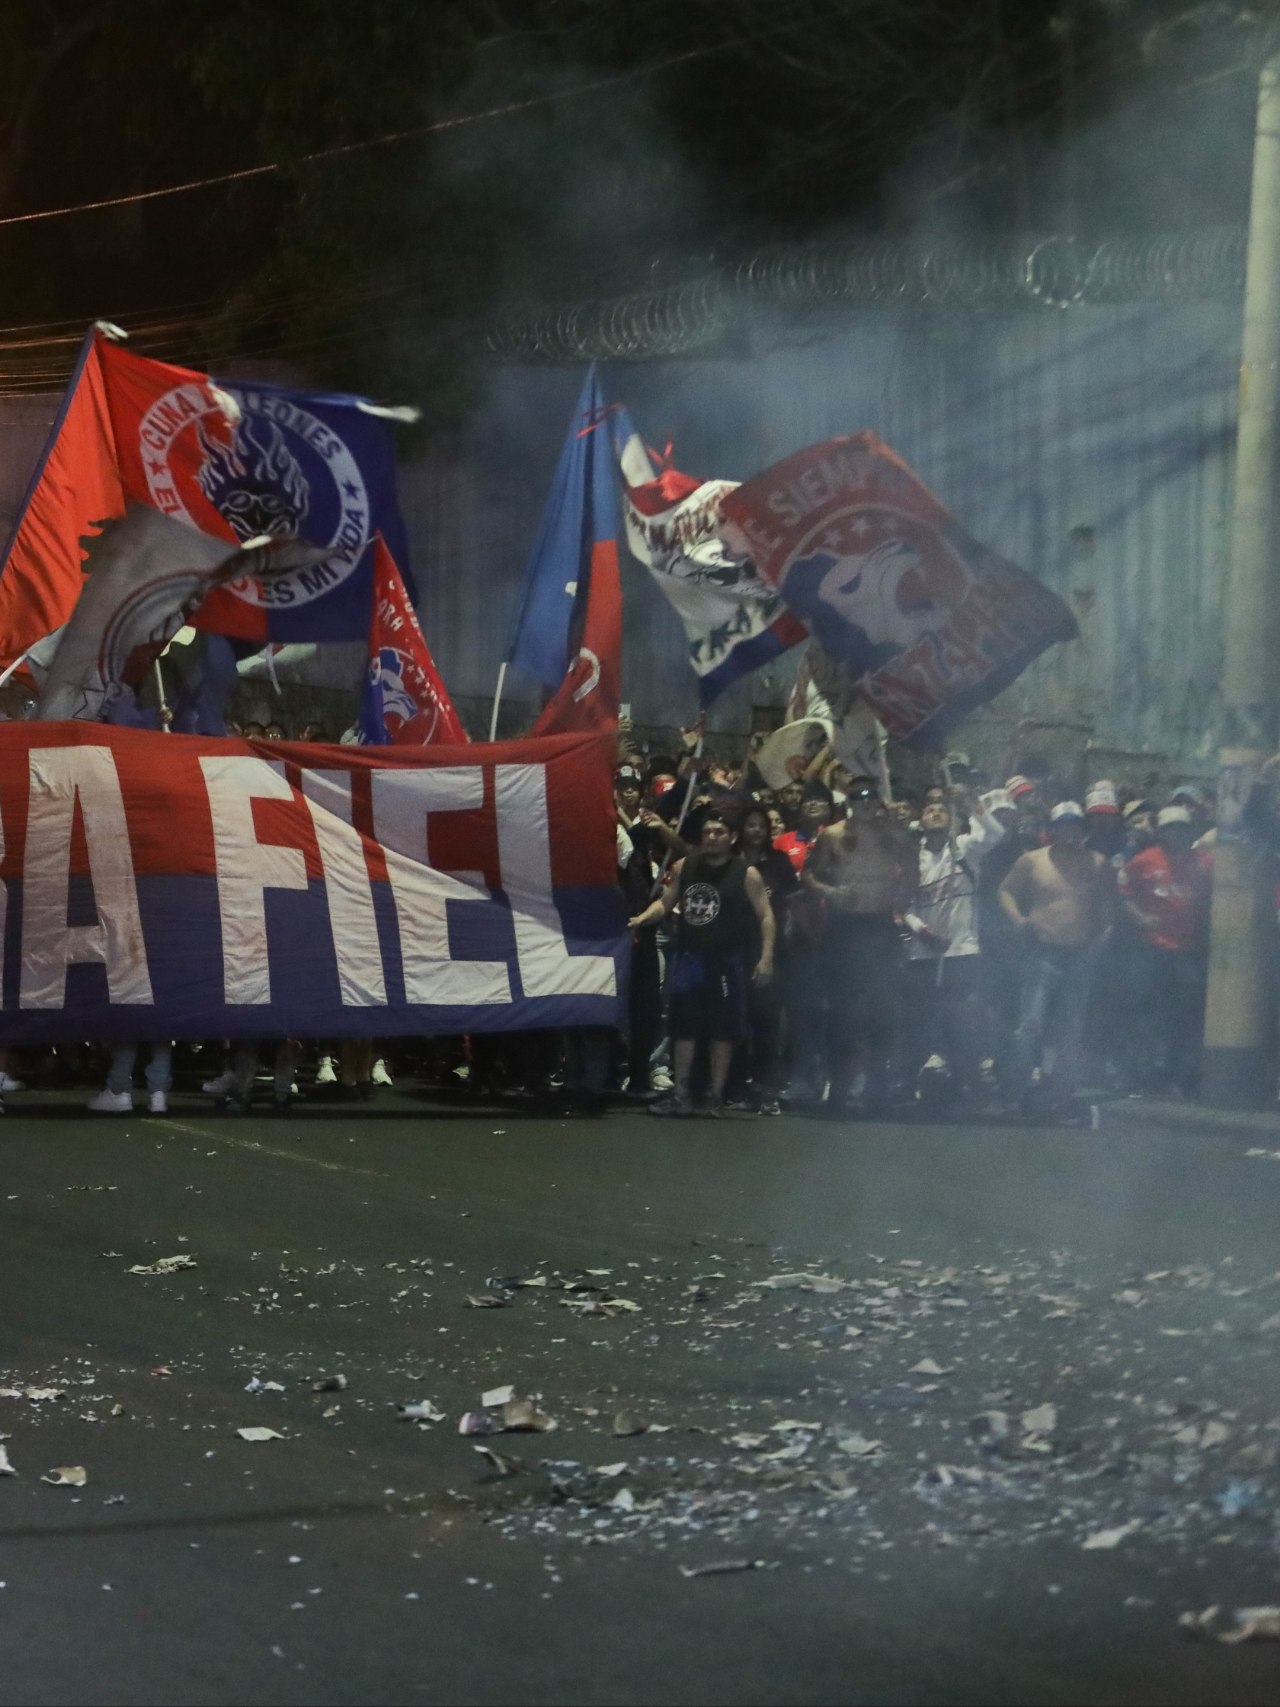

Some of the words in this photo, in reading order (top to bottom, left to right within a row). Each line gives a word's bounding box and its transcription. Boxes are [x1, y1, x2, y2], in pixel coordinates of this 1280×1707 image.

[141, 391, 200, 451] CUNA
[296, 560, 339, 596] MI
[198, 755, 618, 1008] FIEL
